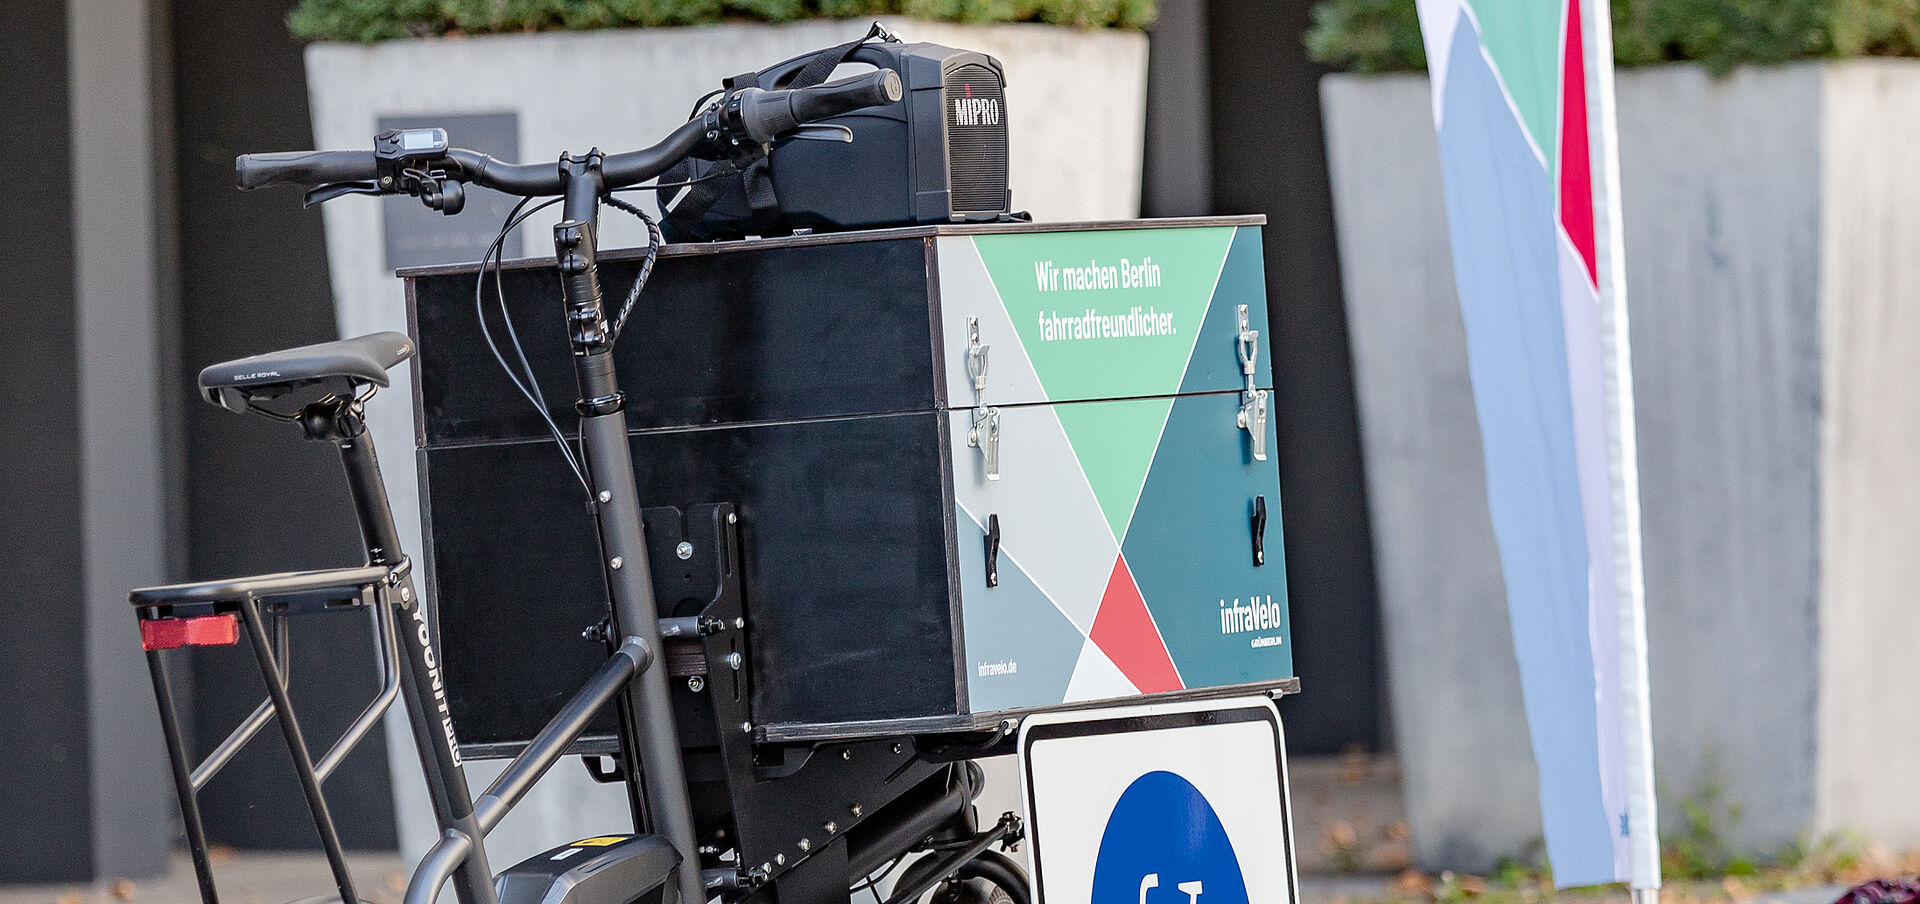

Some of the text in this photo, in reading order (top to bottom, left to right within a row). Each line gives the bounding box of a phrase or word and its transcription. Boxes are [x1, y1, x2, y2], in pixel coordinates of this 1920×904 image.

[954, 98, 999, 126] MIPRO
[1034, 256, 1162, 292] Wir machen Berlin
[1038, 305, 1177, 342] fahrradfreundlicher.
[1219, 594, 1281, 635] infraVelo
[412, 607, 450, 716] YOONIT
[977, 658, 1018, 677] infravelo.de
